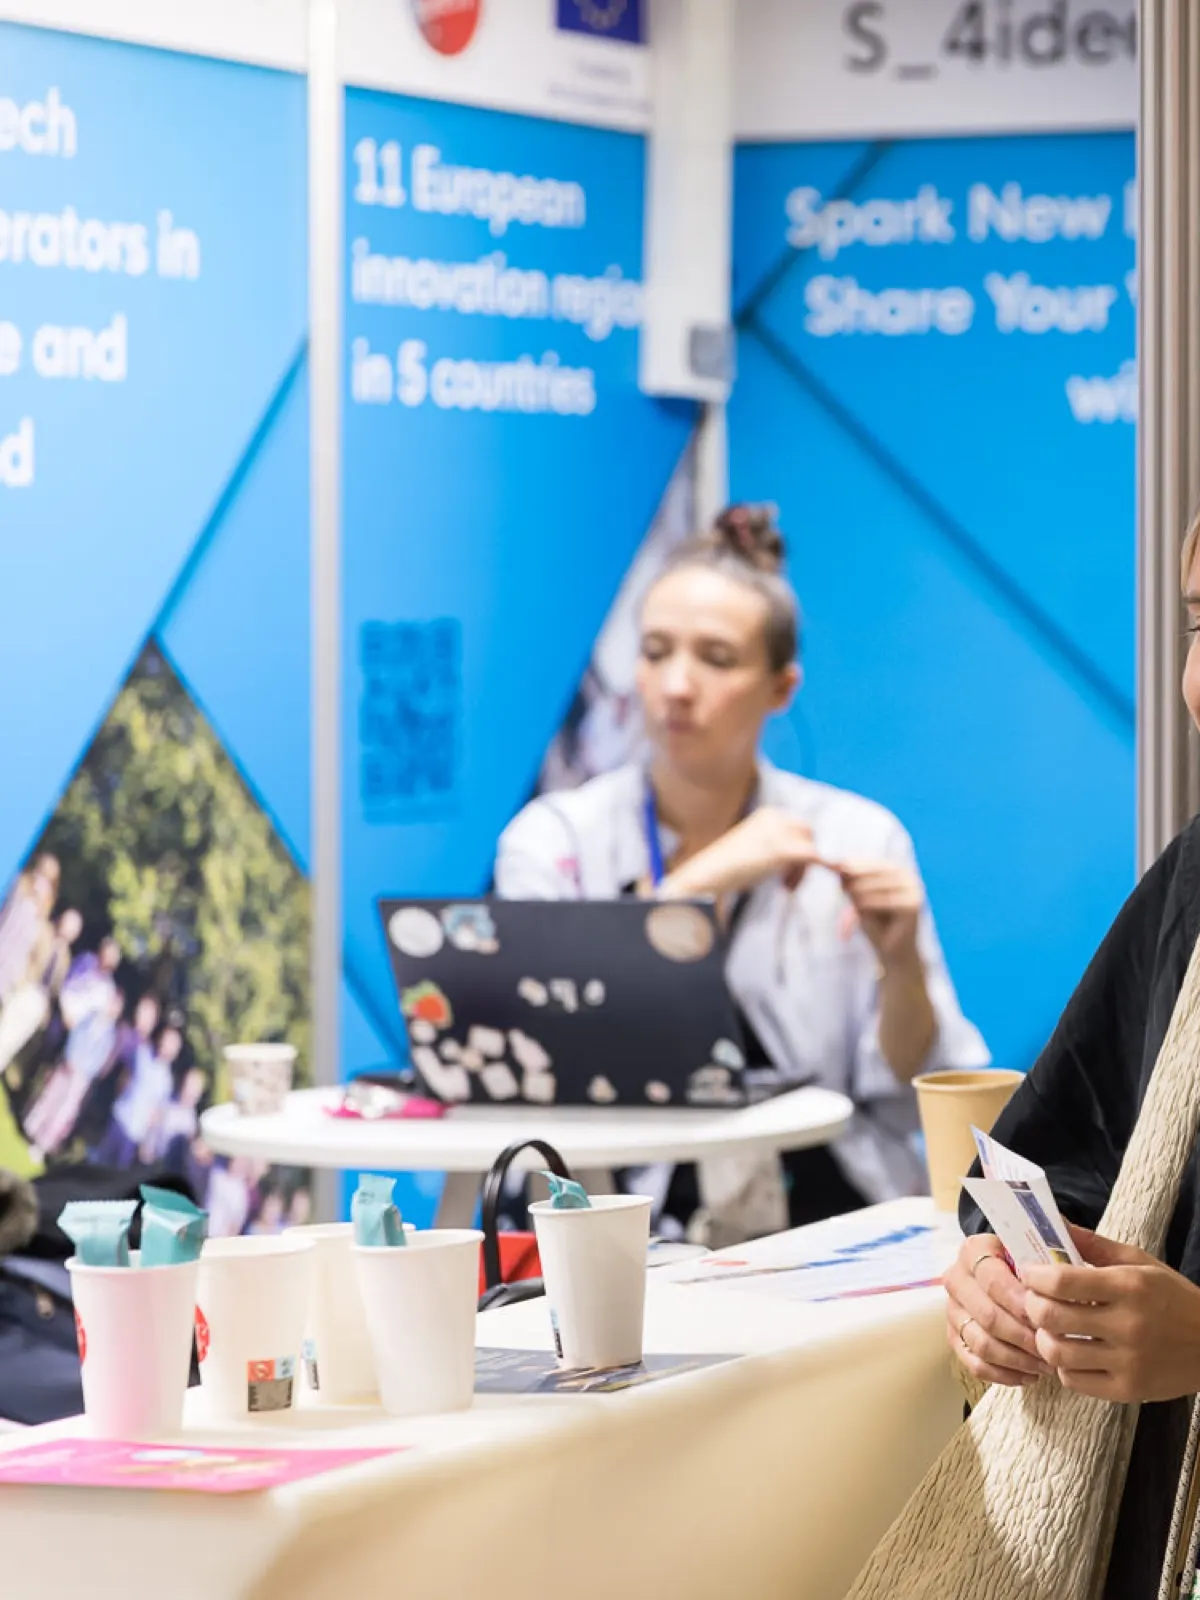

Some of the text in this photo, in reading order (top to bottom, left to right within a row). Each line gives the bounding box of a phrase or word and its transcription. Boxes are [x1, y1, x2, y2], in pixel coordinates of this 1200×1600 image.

[354, 138, 585, 236] 11 European
[786, 186, 955, 262] Spark
[967, 182, 1111, 243] New
[156, 208, 200, 281] in
[352, 238, 549, 319] innovation
[804, 274, 974, 336] Share
[984, 271, 1118, 334] Your
[33, 312, 127, 382] and
[352, 338, 597, 415] in 5 countries
